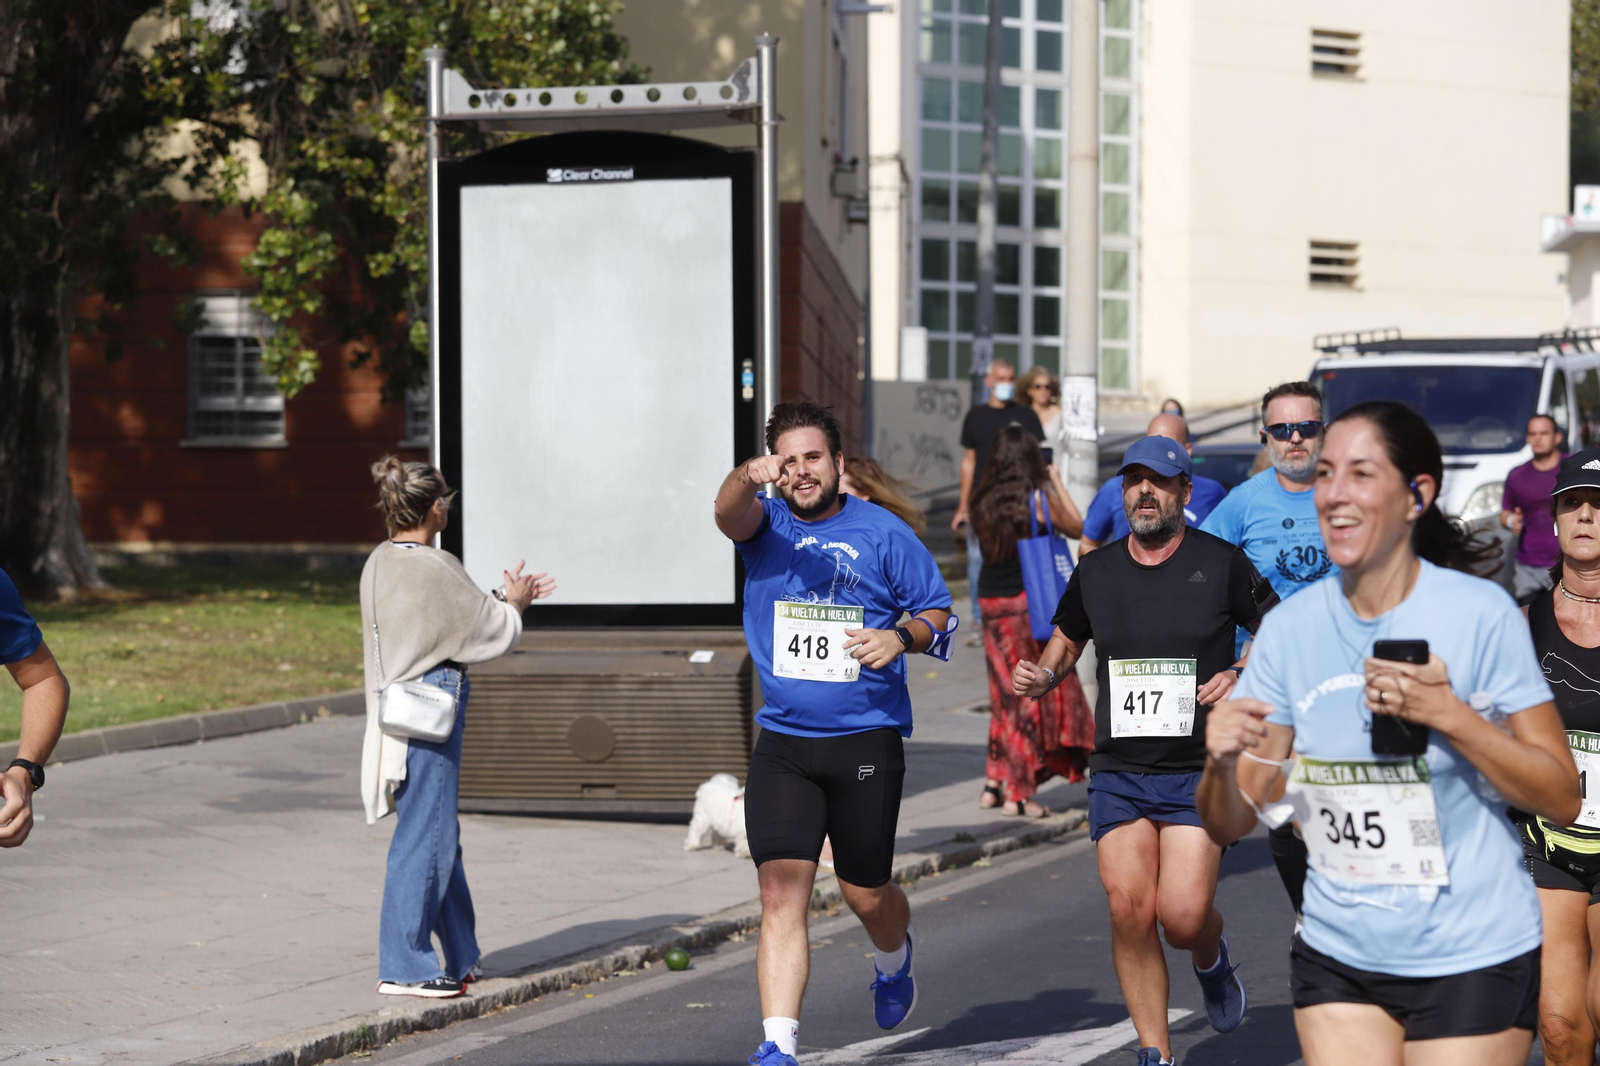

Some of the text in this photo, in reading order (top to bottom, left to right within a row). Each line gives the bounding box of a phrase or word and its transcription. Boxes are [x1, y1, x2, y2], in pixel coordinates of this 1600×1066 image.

[563, 167, 634, 181] Clear Channel
[1290, 545, 1318, 567] 30
[780, 607, 857, 621] 34 VUELTA A HUELVA
[788, 634, 829, 660] 418
[1115, 663, 1190, 675] 34 VUELTA A HUELVA
[1123, 690, 1164, 715] 417
[1580, 736, 1586, 749] A
[1307, 764, 1355, 784] VUELTA
[1355, 765, 1368, 783] A
[1366, 764, 1420, 783] HUELVA
[1320, 808, 1386, 849] 345
